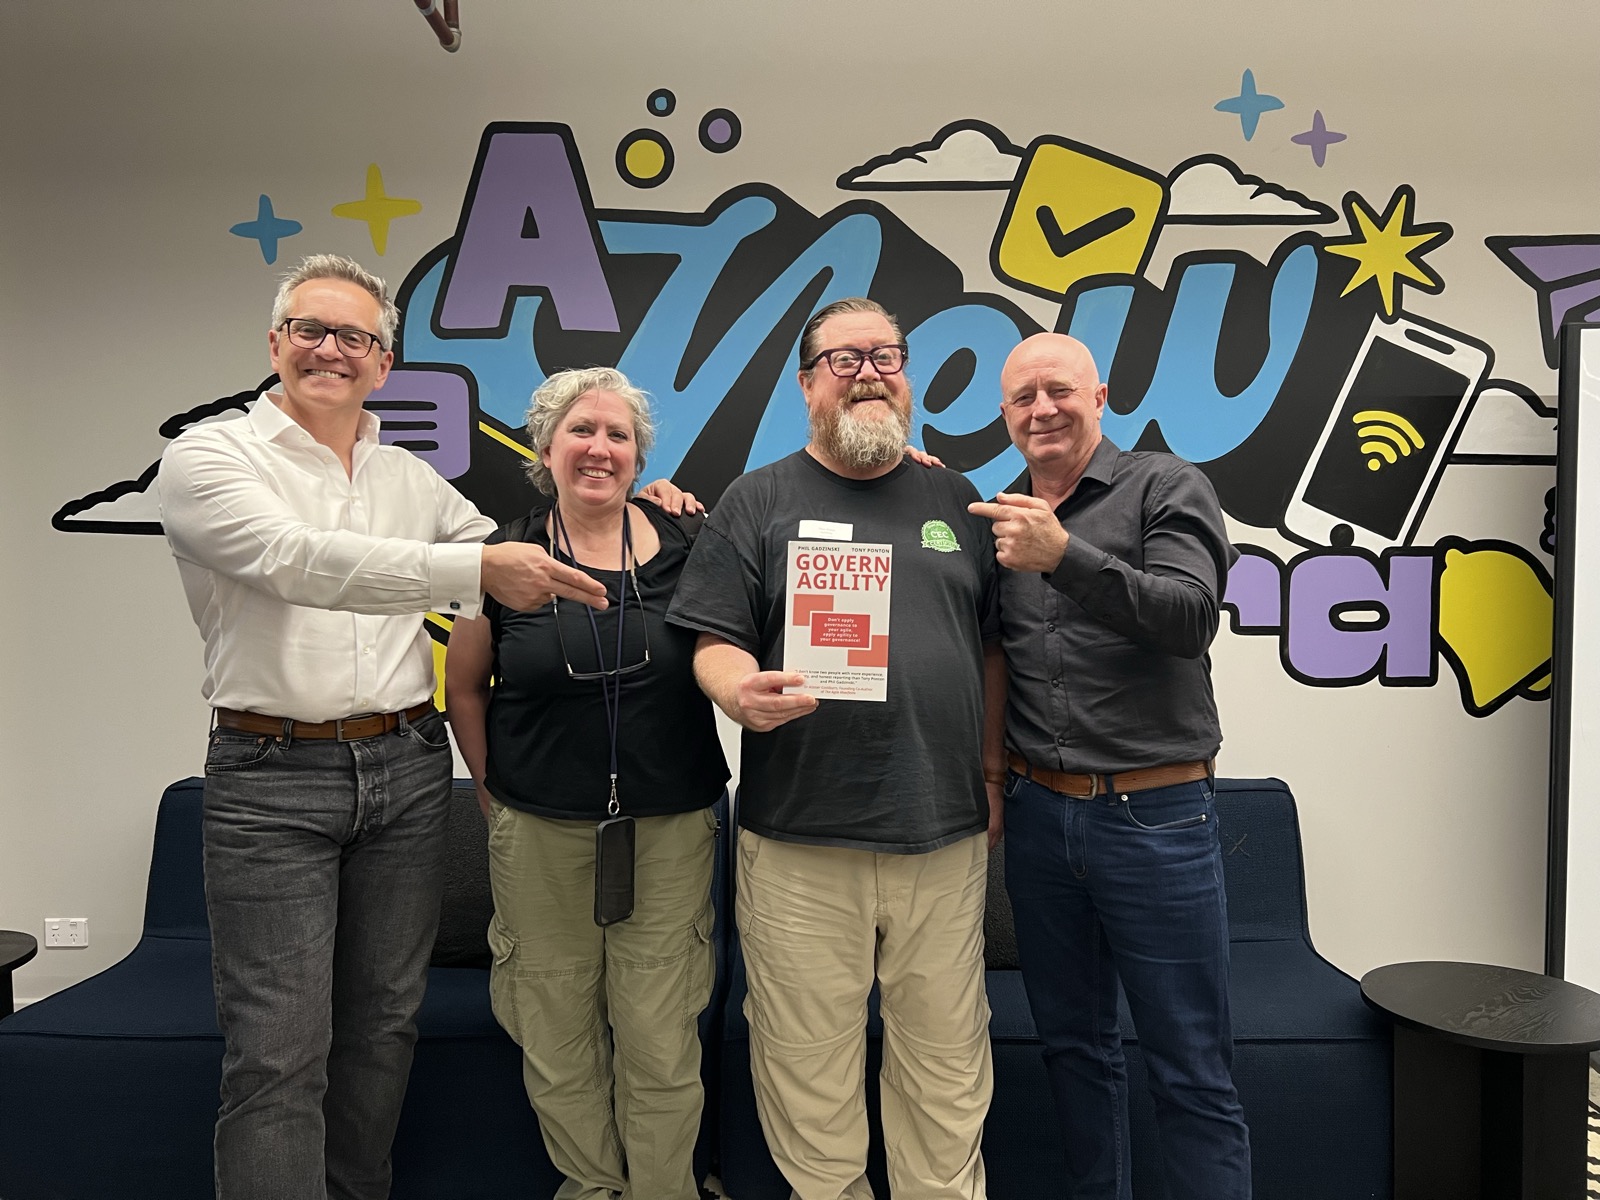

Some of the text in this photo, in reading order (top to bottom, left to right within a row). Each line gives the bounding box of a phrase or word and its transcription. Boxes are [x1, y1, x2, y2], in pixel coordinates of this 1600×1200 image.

[435, 124, 621, 336] A
[403, 196, 1318, 500] New
[930, 531, 949, 539] CEC
[796, 553, 890, 573] GOVERN
[796, 572, 889, 592] AGILITY
